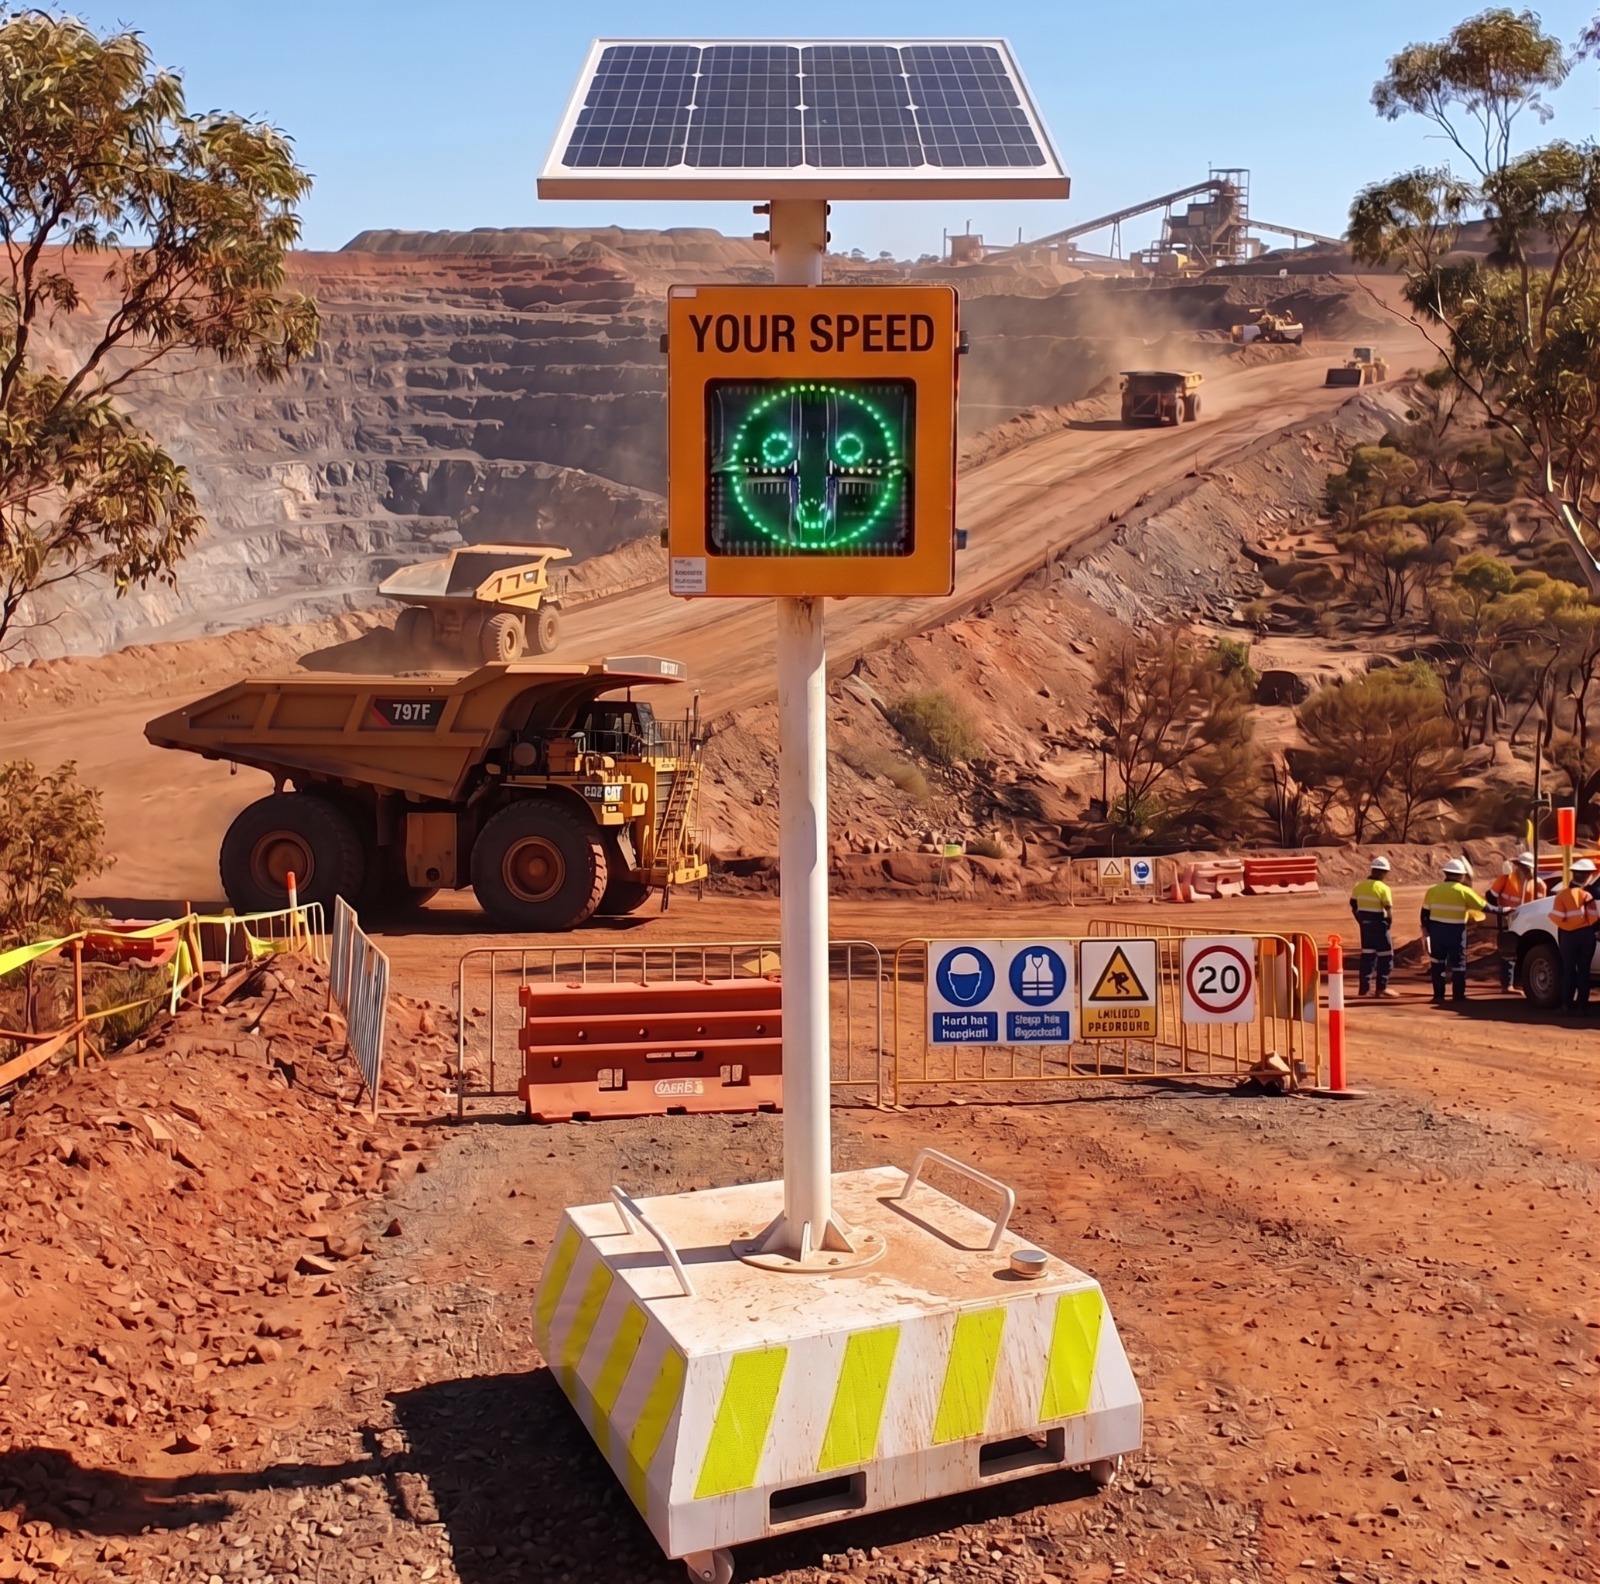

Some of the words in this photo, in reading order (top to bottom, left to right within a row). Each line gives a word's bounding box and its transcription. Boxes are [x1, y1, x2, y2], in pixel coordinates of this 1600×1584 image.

[688, 314, 796, 353] YOUR
[809, 314, 935, 353] SPEED
[392, 703, 431, 721] 797F
[1197, 964, 1241, 994] 20
[942, 1015, 968, 1026] Hard
[970, 1015, 988, 1025] hat
